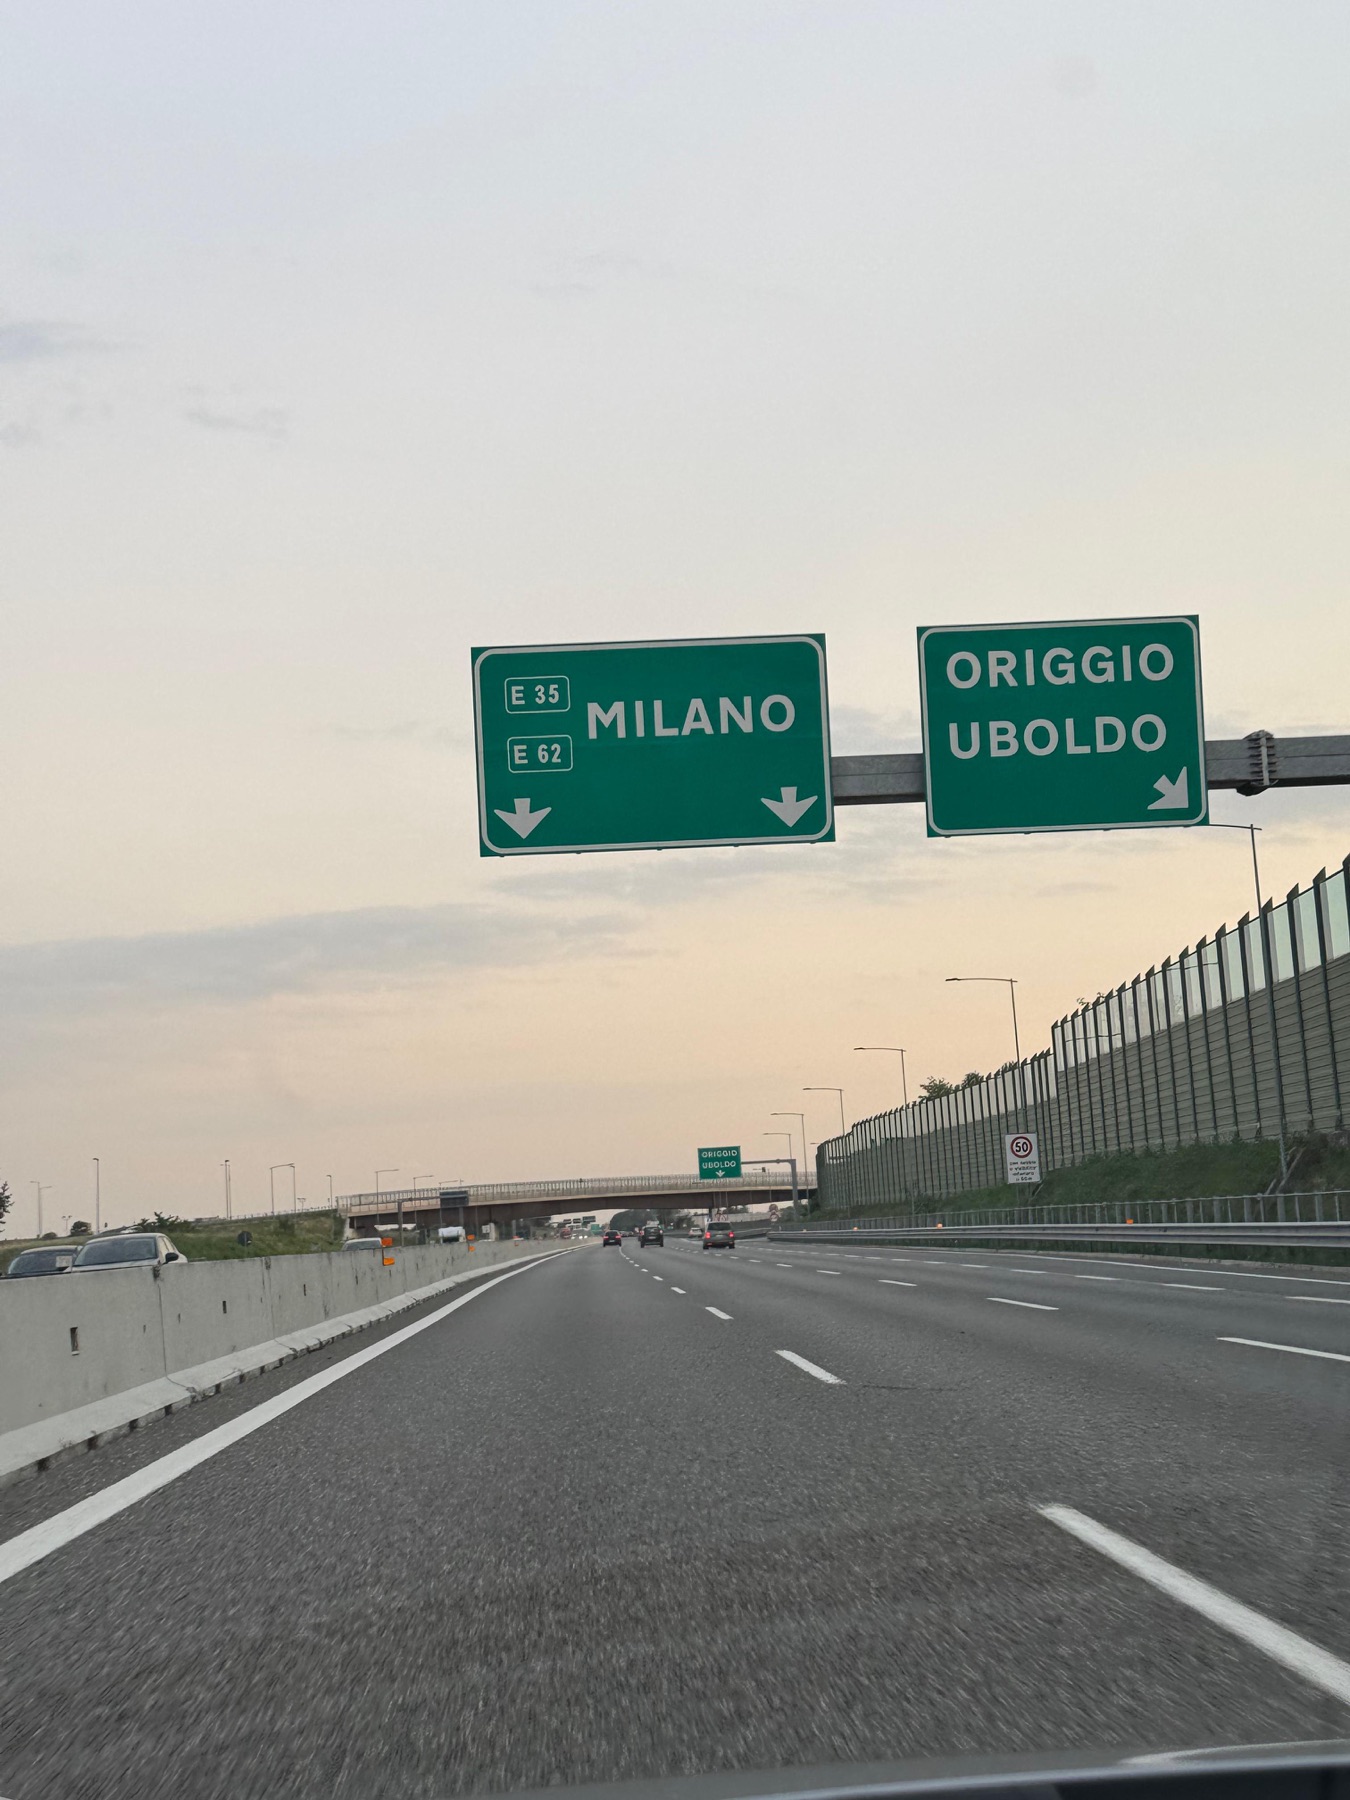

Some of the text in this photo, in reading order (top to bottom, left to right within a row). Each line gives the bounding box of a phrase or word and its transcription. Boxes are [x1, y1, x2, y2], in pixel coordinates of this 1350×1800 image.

[946, 643, 1174, 689] ORIGGIO
[511, 684, 560, 705] E 35
[587, 694, 796, 739] MILANO
[948, 714, 1167, 759] UBOLDO
[513, 744, 561, 764] E 62
[1015, 1141, 1028, 1152] 50
